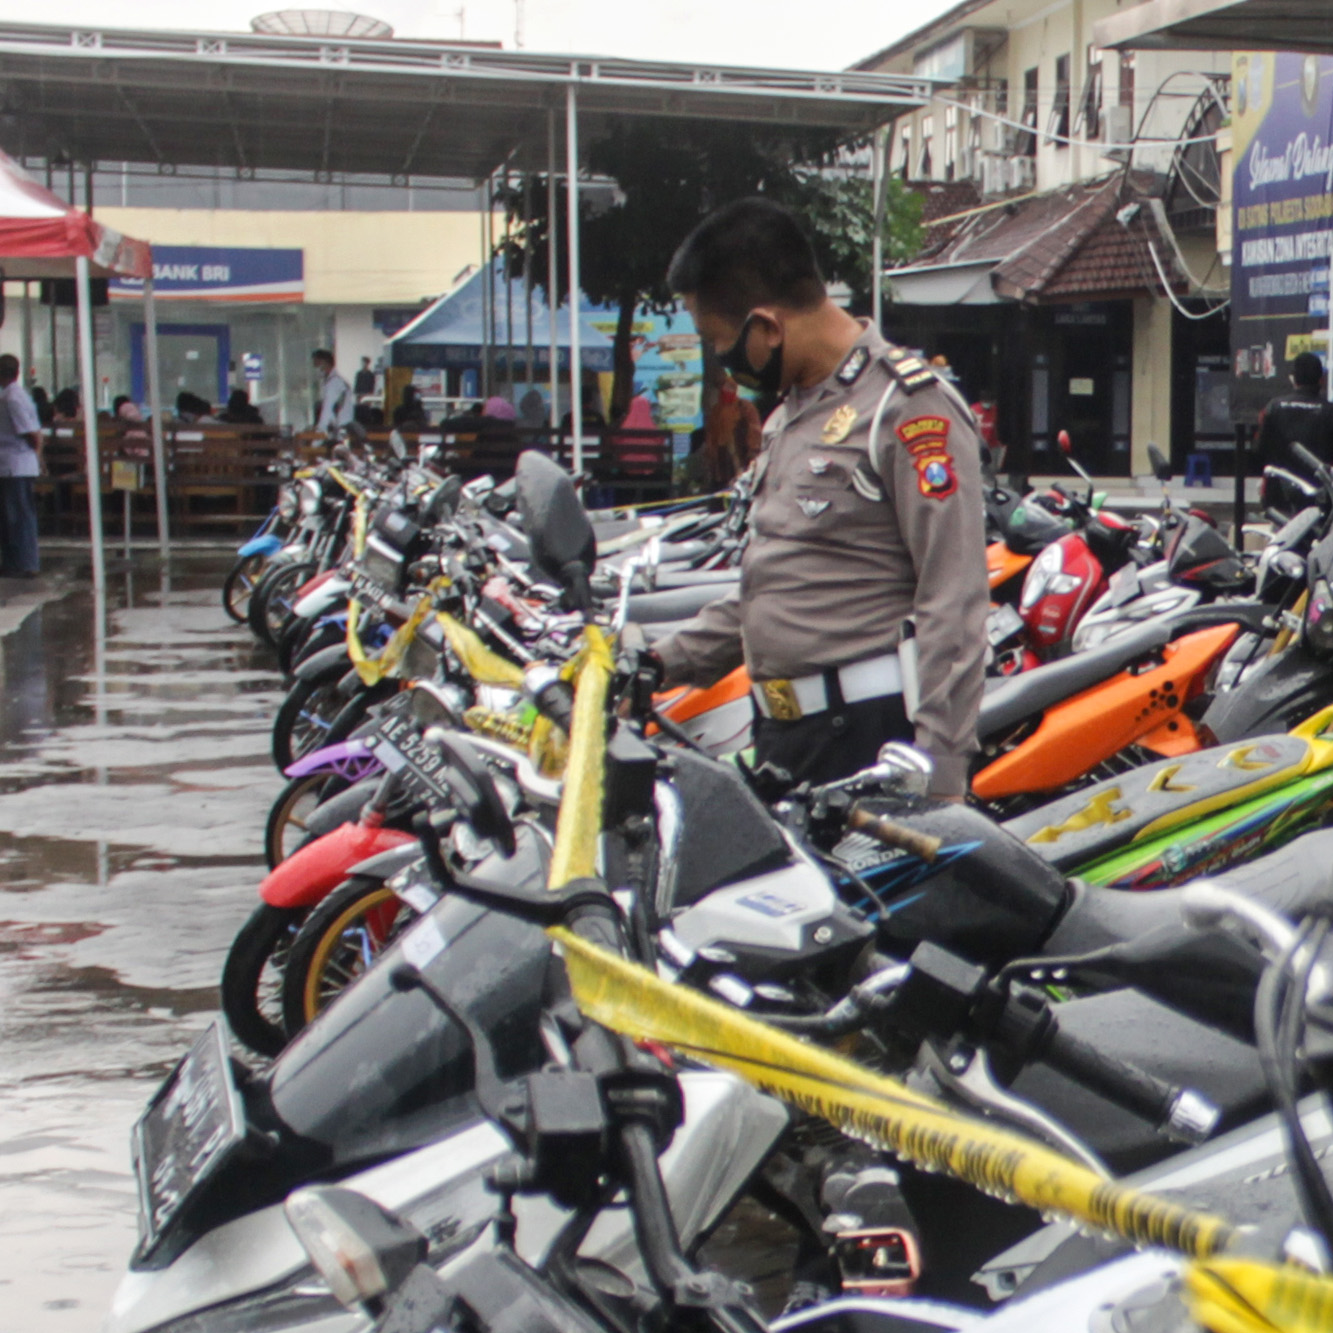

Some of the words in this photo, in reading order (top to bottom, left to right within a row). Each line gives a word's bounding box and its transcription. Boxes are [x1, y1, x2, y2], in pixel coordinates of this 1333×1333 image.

[152, 264, 198, 281] BANK
[201, 265, 230, 282] BRI
[381, 716, 408, 741] AE
